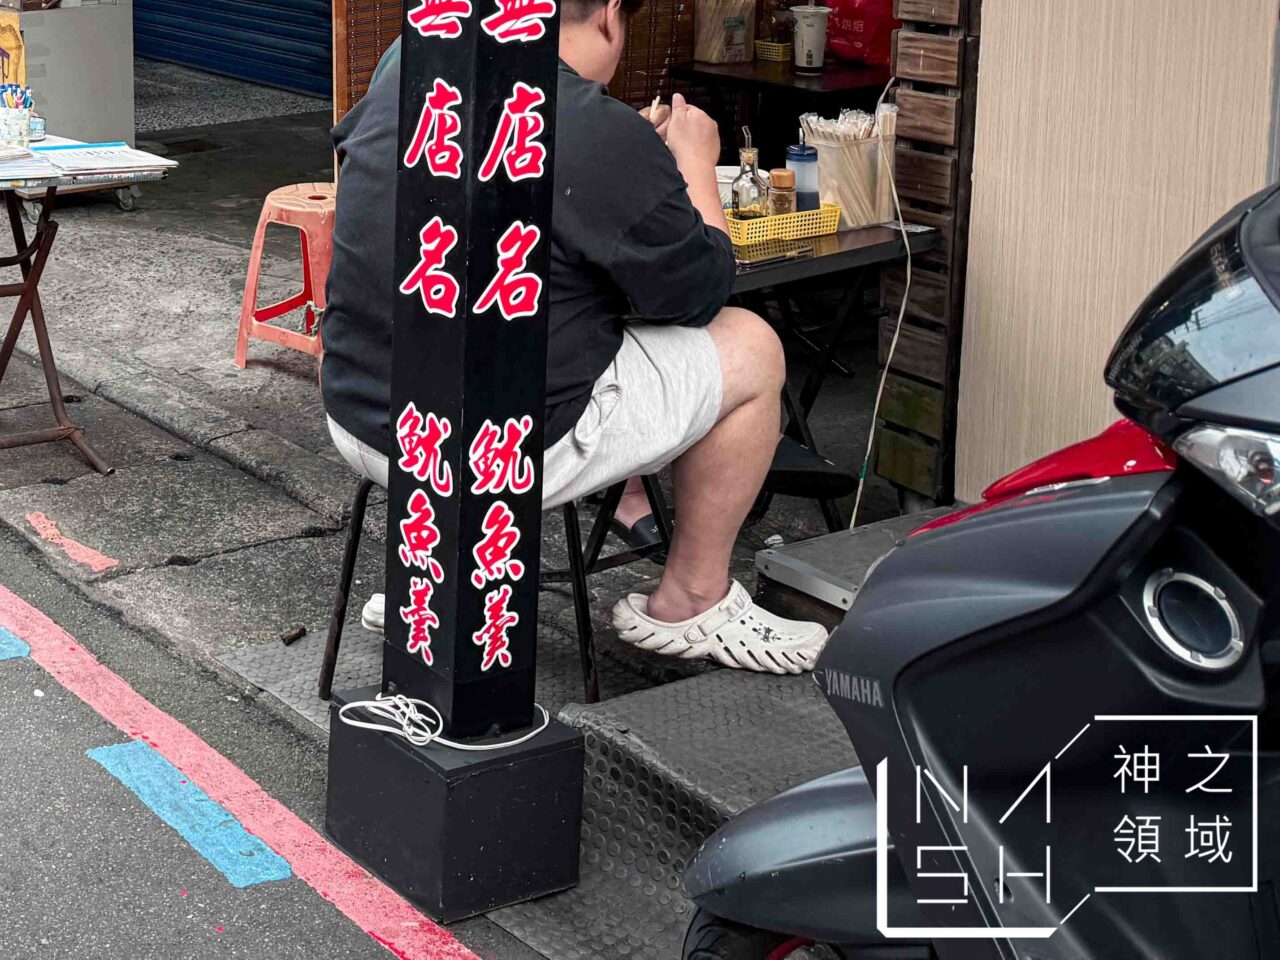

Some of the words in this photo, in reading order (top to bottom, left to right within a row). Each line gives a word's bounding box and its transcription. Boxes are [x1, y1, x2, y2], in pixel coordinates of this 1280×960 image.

[396, 401, 453, 667] 魷魚羹
[469, 414, 534, 672] 魷魚羹
[825, 667, 885, 708] YAMAHA
